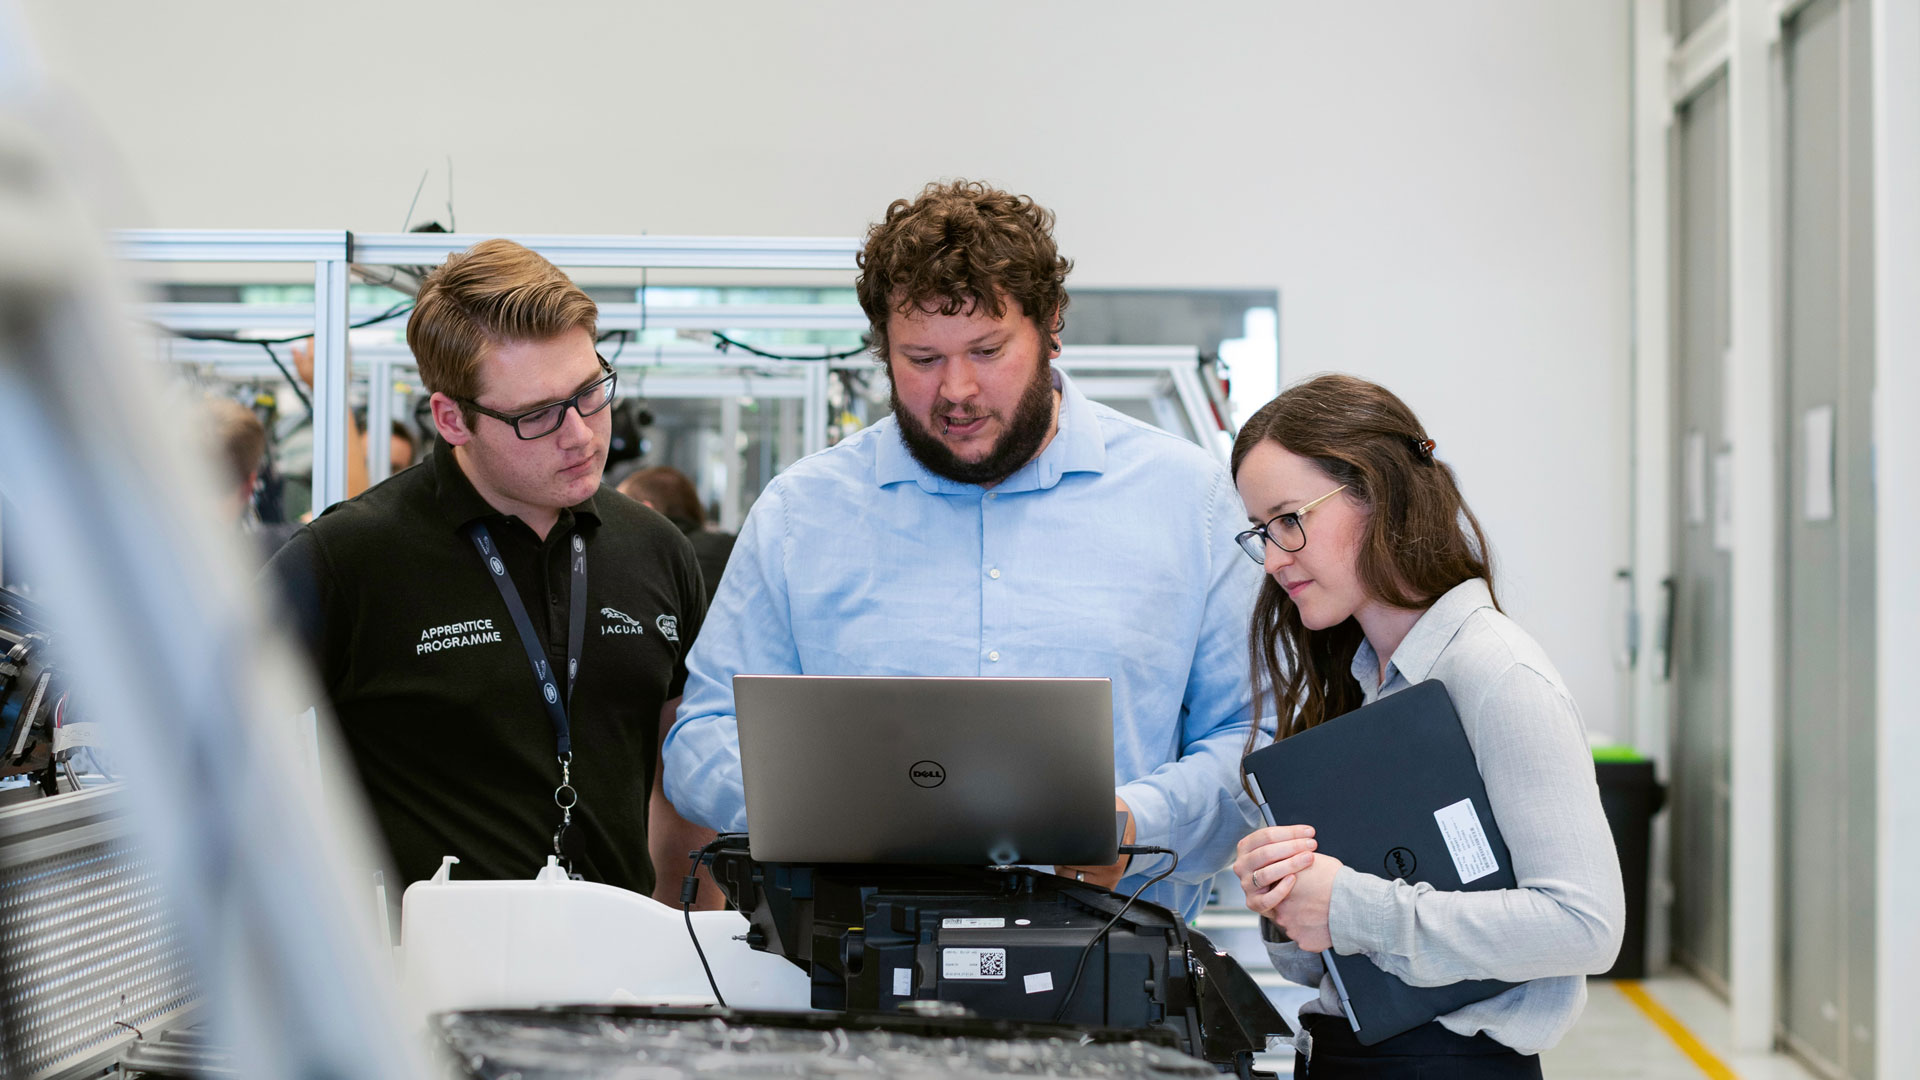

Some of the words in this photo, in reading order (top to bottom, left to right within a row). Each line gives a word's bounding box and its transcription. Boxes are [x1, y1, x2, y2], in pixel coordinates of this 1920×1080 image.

[421, 619, 494, 641] APPRENTICE
[601, 625, 644, 635] JAGUAR
[416, 631, 502, 655] PROGRAMME
[913, 770, 942, 778] DELL
[1392, 851, 1408, 875] DELL
